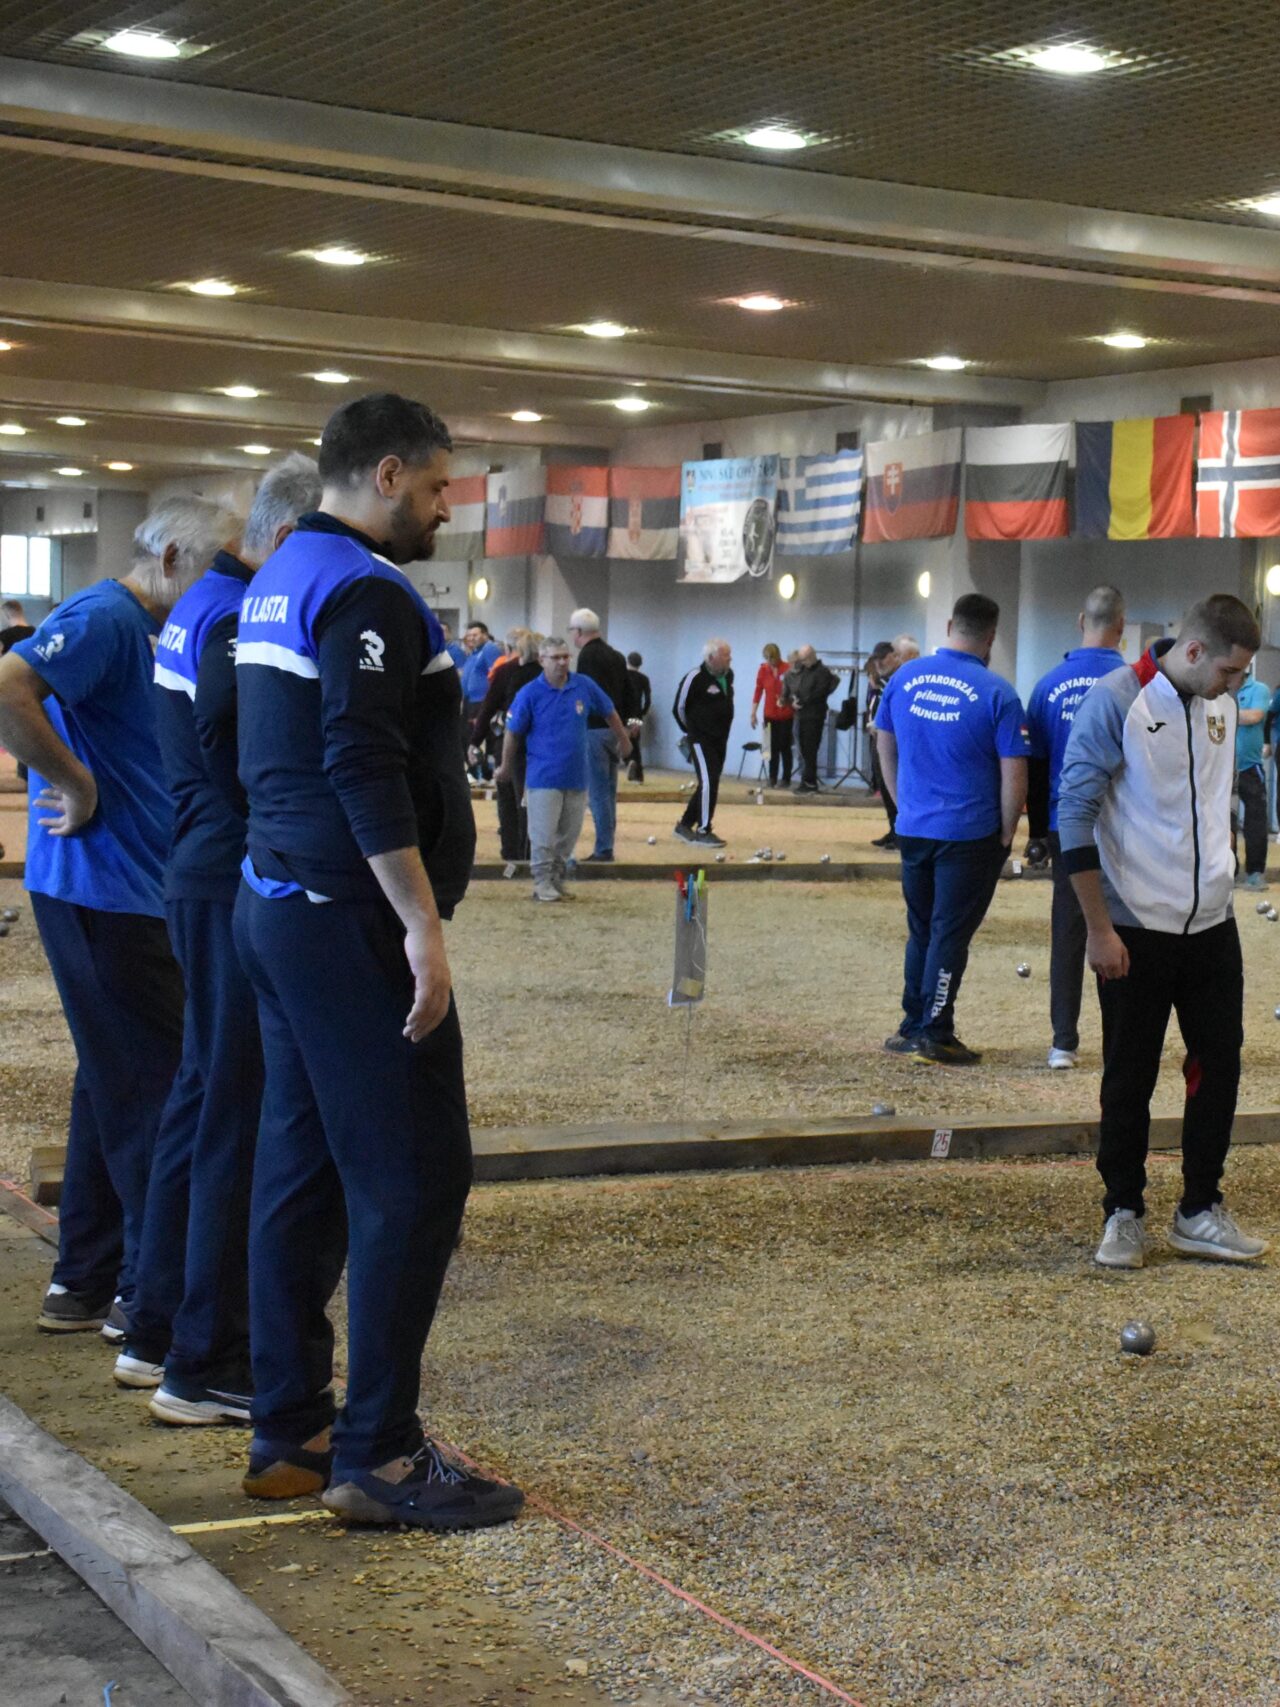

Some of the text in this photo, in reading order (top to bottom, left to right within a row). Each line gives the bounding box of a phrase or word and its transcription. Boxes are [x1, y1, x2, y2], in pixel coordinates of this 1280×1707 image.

[250, 596, 289, 624] LASTA
[903, 674, 979, 702] MAGYARORSZÁG
[909, 703, 961, 722] HUNGARY
[930, 967, 952, 1019] Joma
